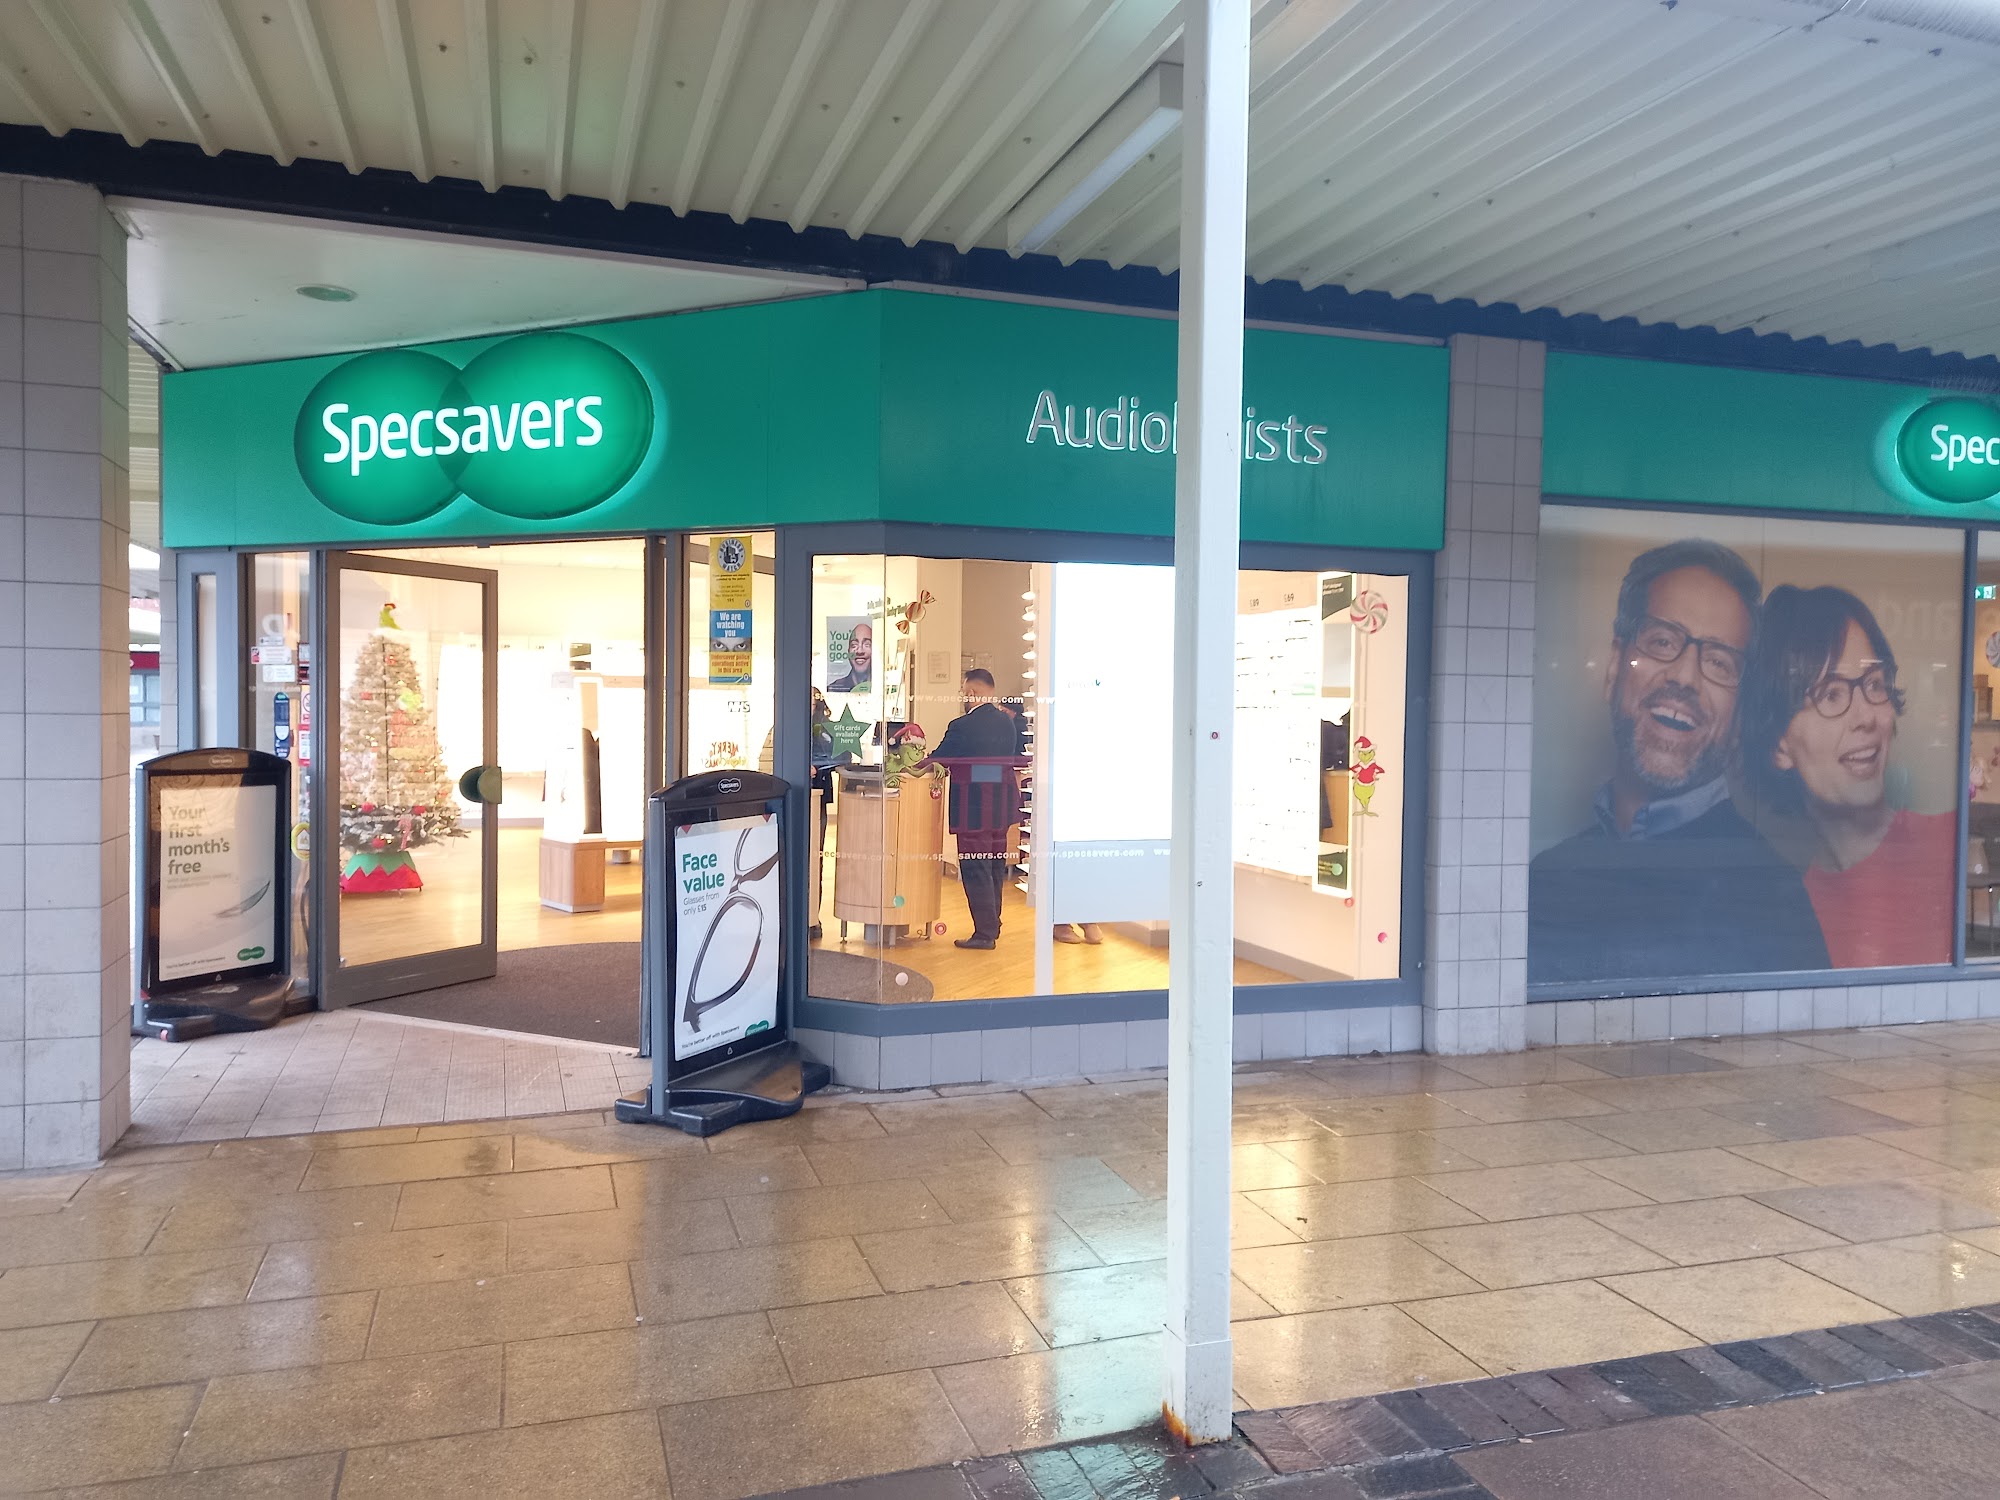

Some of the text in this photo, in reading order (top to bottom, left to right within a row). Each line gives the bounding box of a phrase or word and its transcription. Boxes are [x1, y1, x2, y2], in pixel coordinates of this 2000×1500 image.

[1025, 389, 1329, 465] Audioists
[322, 395, 603, 476] Specsavers
[720, 612, 742, 621] We are
[716, 621, 745, 630] watching
[724, 629, 736, 638] you
[829, 641, 843, 651] do
[907, 695, 1024, 704] www.specsavers.com
[168, 806, 206, 820] Your
[168, 823, 202, 839] first
[168, 837, 230, 857] month's
[167, 859, 202, 875] free
[682, 853, 718, 873] Face
[682, 871, 725, 894] value
[683, 892, 720, 906] Glasses from
[683, 903, 707, 916] only £15
